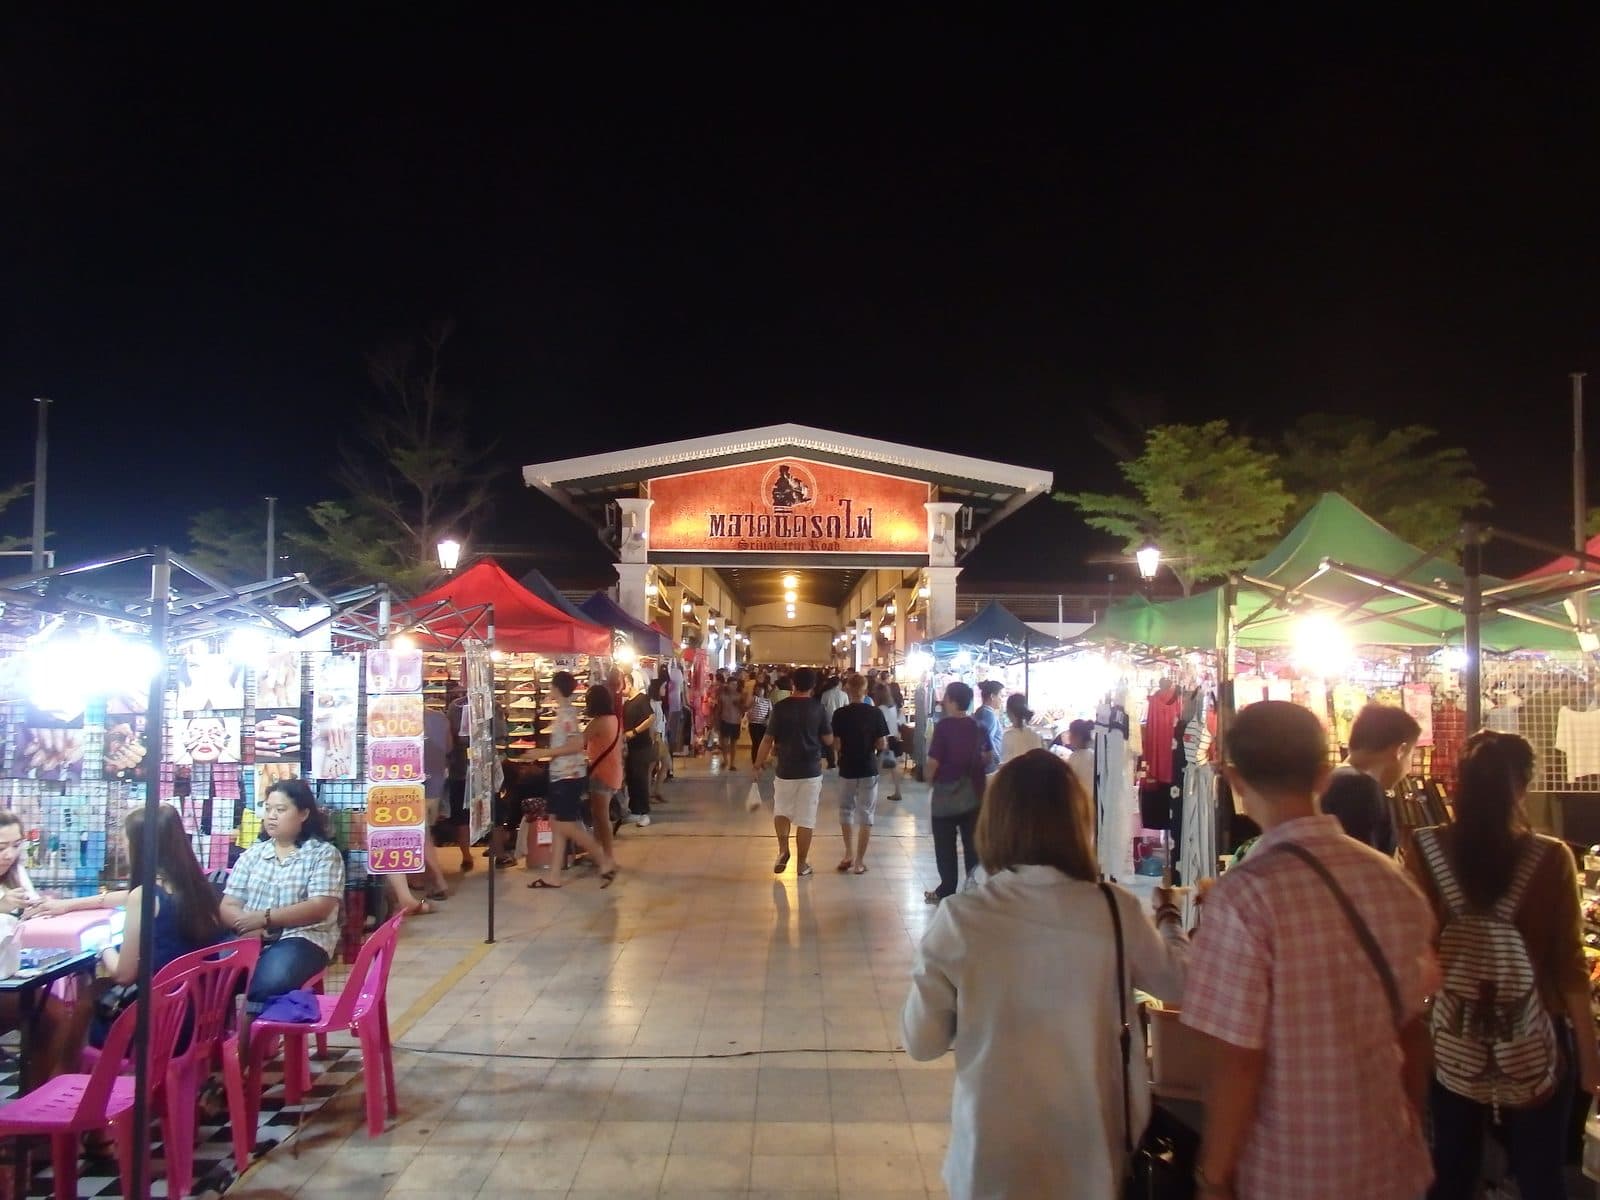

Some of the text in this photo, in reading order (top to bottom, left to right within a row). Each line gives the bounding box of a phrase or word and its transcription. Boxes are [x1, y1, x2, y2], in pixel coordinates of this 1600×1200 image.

[709, 498, 873, 539] ตลาดนัดรถไฟ
[809, 538, 841, 551] Road
